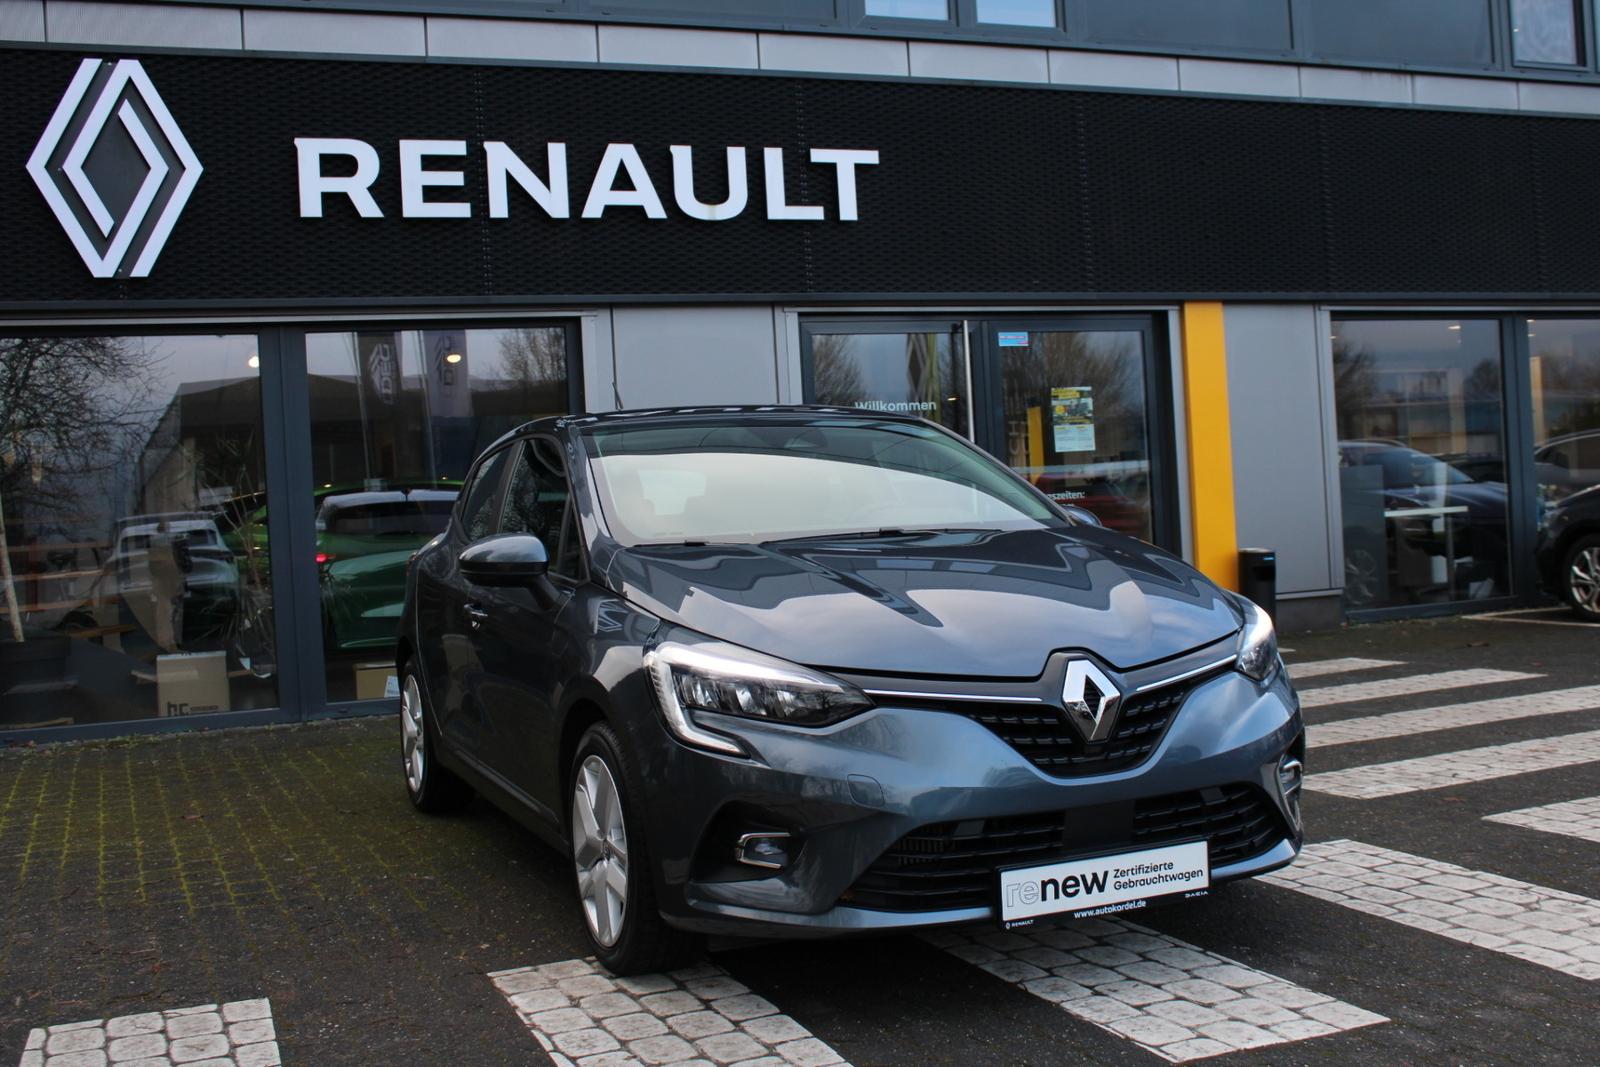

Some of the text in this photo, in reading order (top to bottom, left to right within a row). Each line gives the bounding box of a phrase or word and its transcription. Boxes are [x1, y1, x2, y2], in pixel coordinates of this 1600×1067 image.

[294, 137, 880, 221] RENAULT
[855, 401, 937, 411] Willkommen
[1113, 860, 1174, 879] Zertifizierte
[1113, 868, 1204, 891] Gebrauchtwagen
[1006, 870, 1109, 907] renew
[1074, 899, 1147, 919] www.autokordel.de
[1011, 919, 1034, 927] RENAULT
